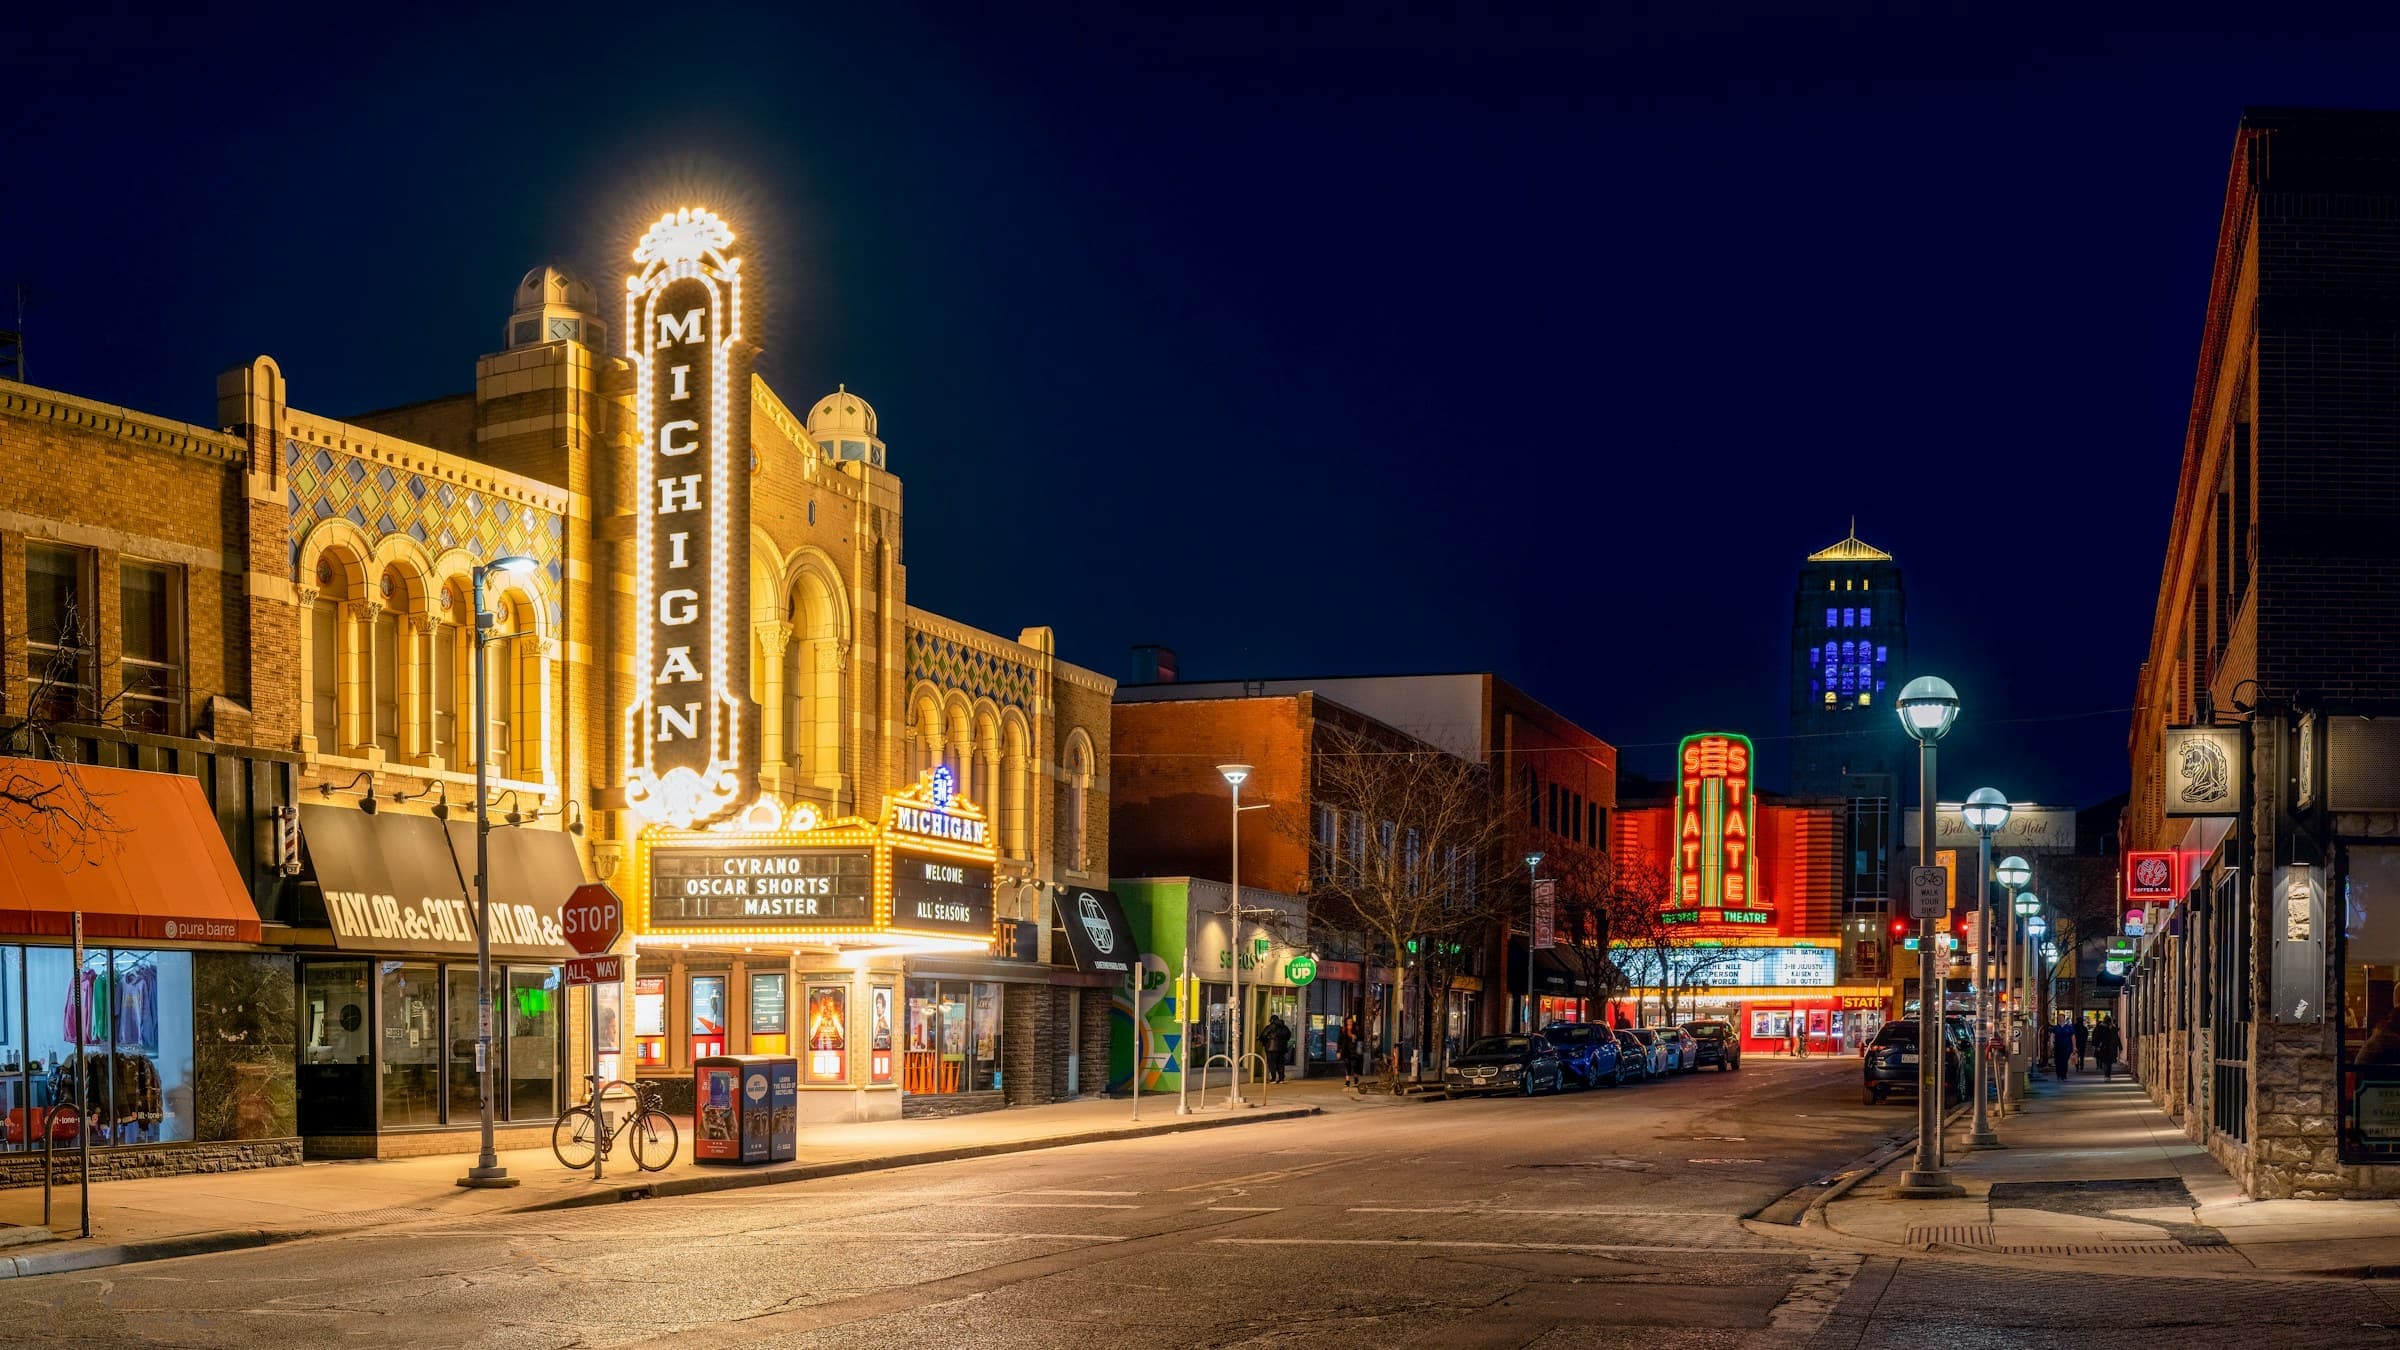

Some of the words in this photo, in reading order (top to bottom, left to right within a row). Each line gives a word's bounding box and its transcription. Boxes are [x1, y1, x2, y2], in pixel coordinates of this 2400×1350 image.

[656, 307, 705, 742] MICHIGAN
[896, 806, 985, 844] MICHIGAN
[1682, 746, 1700, 901] STATE
[1725, 746, 1747, 901] STATE
[1936, 816, 1964, 836] Bell
[2009, 818, 2049, 836] Hotel
[723, 858, 800, 875] CYRANO
[925, 863, 964, 884] WELCOME
[686, 878, 748, 896] OSCAR
[756, 877, 830, 895] SHORTS
[1920, 888, 1938, 896] WALK
[744, 898, 818, 915] MASTER
[1920, 897, 1939, 905] YOUR
[566, 904, 617, 934] STOP
[917, 902, 933, 918] ALL
[935, 904, 970, 923] SEASONS
[1723, 911, 1768, 924] THEATRE
[179, 922, 204, 938] pure
[206, 920, 236, 937] barre
[566, 963, 587, 982] ALL
[595, 960, 619, 978] WAY
[1291, 968, 1311, 979] UP
[1843, 997, 1883, 1008] STATE
